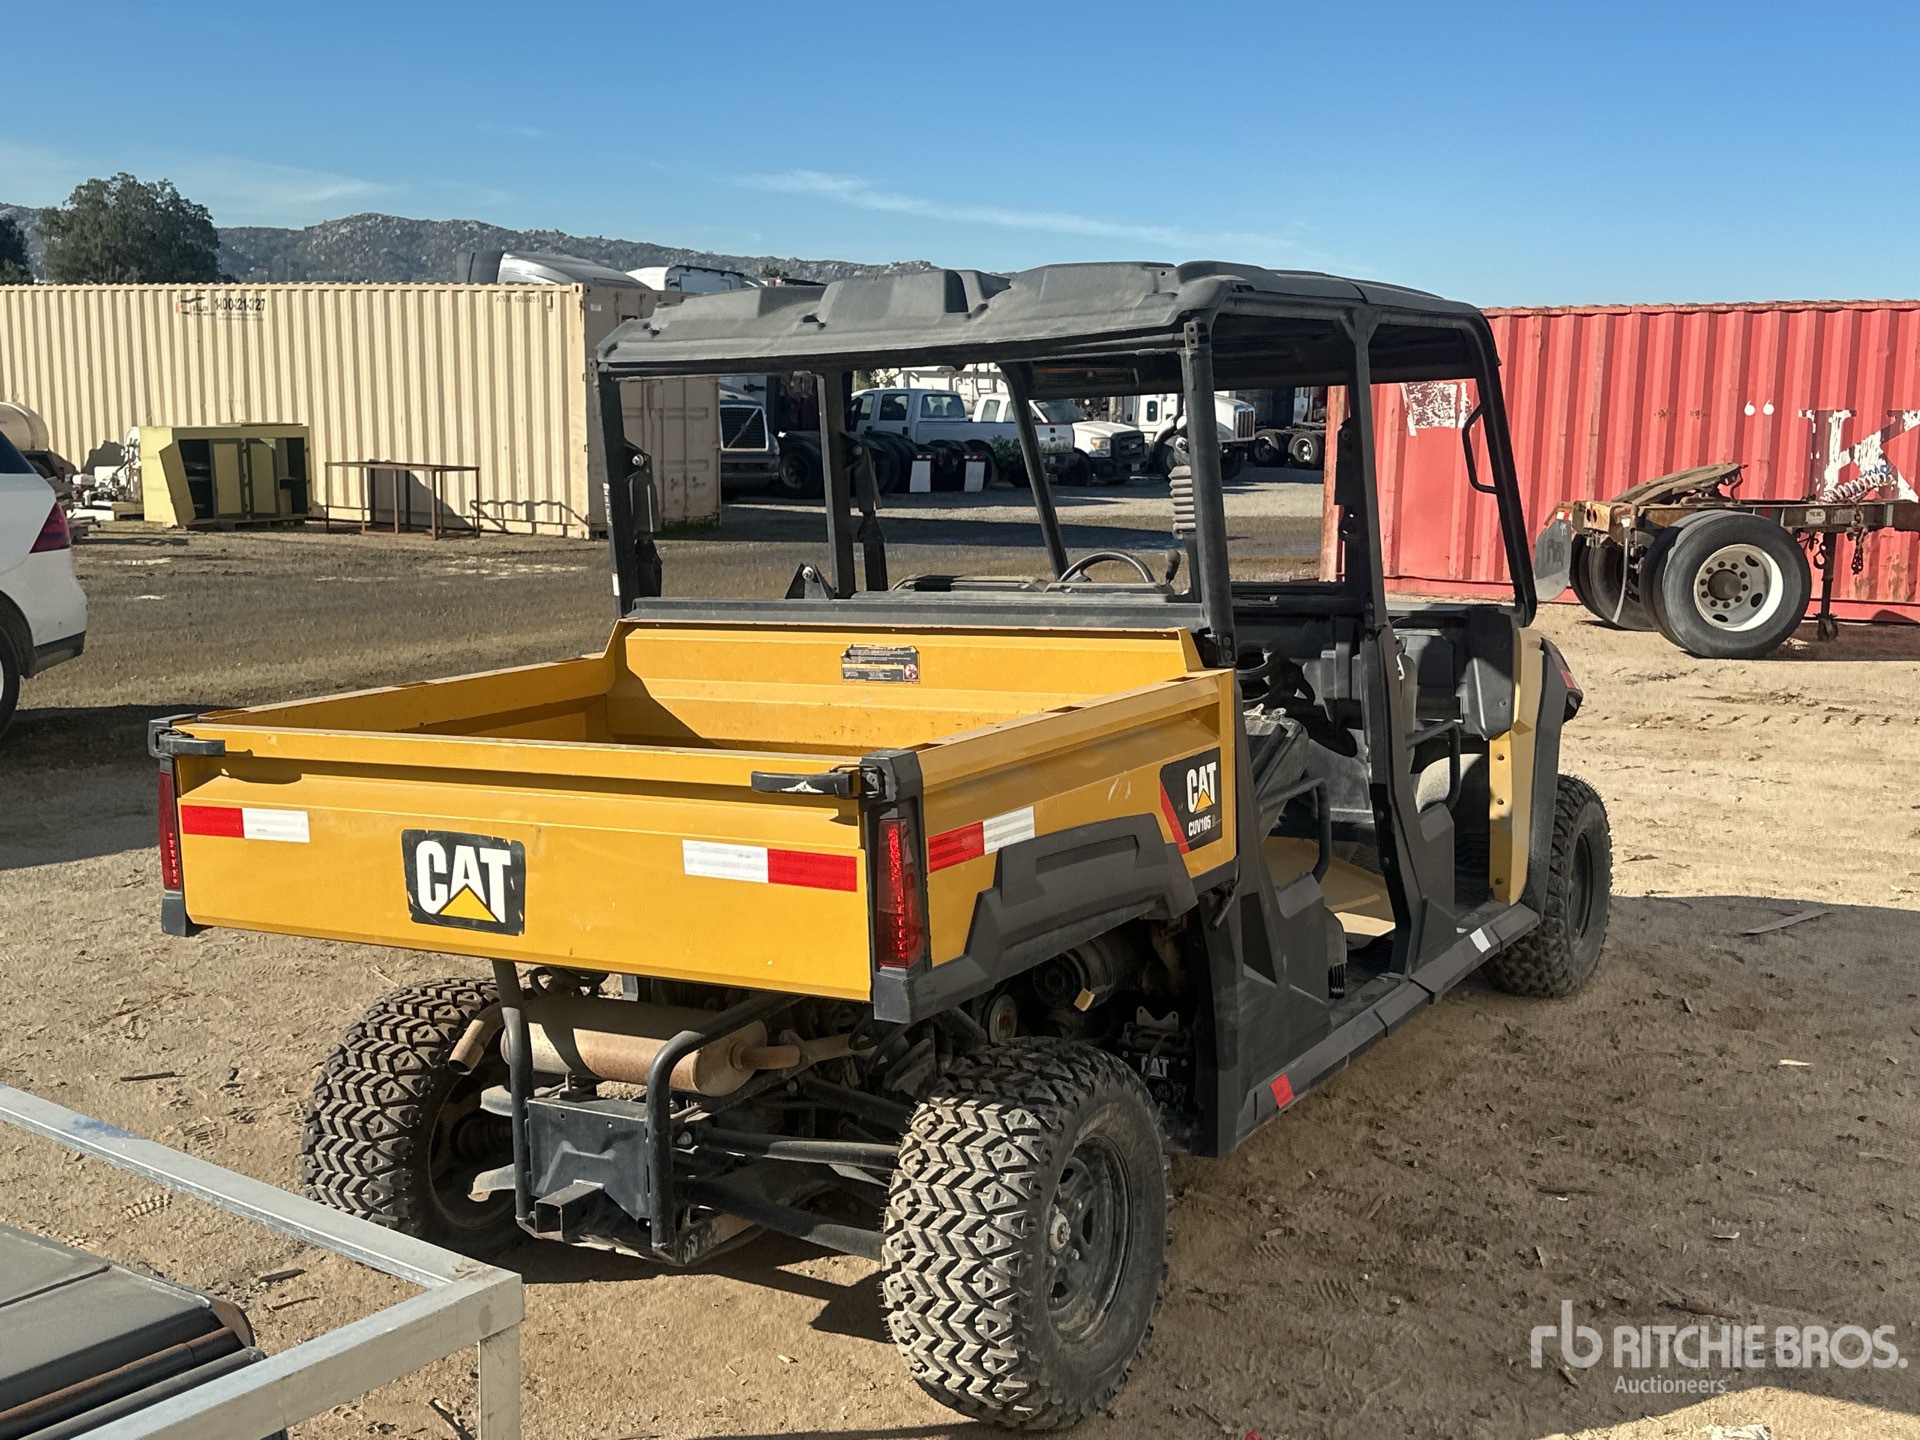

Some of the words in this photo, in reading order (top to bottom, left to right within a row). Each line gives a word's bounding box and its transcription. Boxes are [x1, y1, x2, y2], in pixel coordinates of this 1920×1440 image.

[1186, 761, 1217, 813] CAT
[1188, 815, 1211, 837] CUV105
[416, 840, 512, 924] CAT
